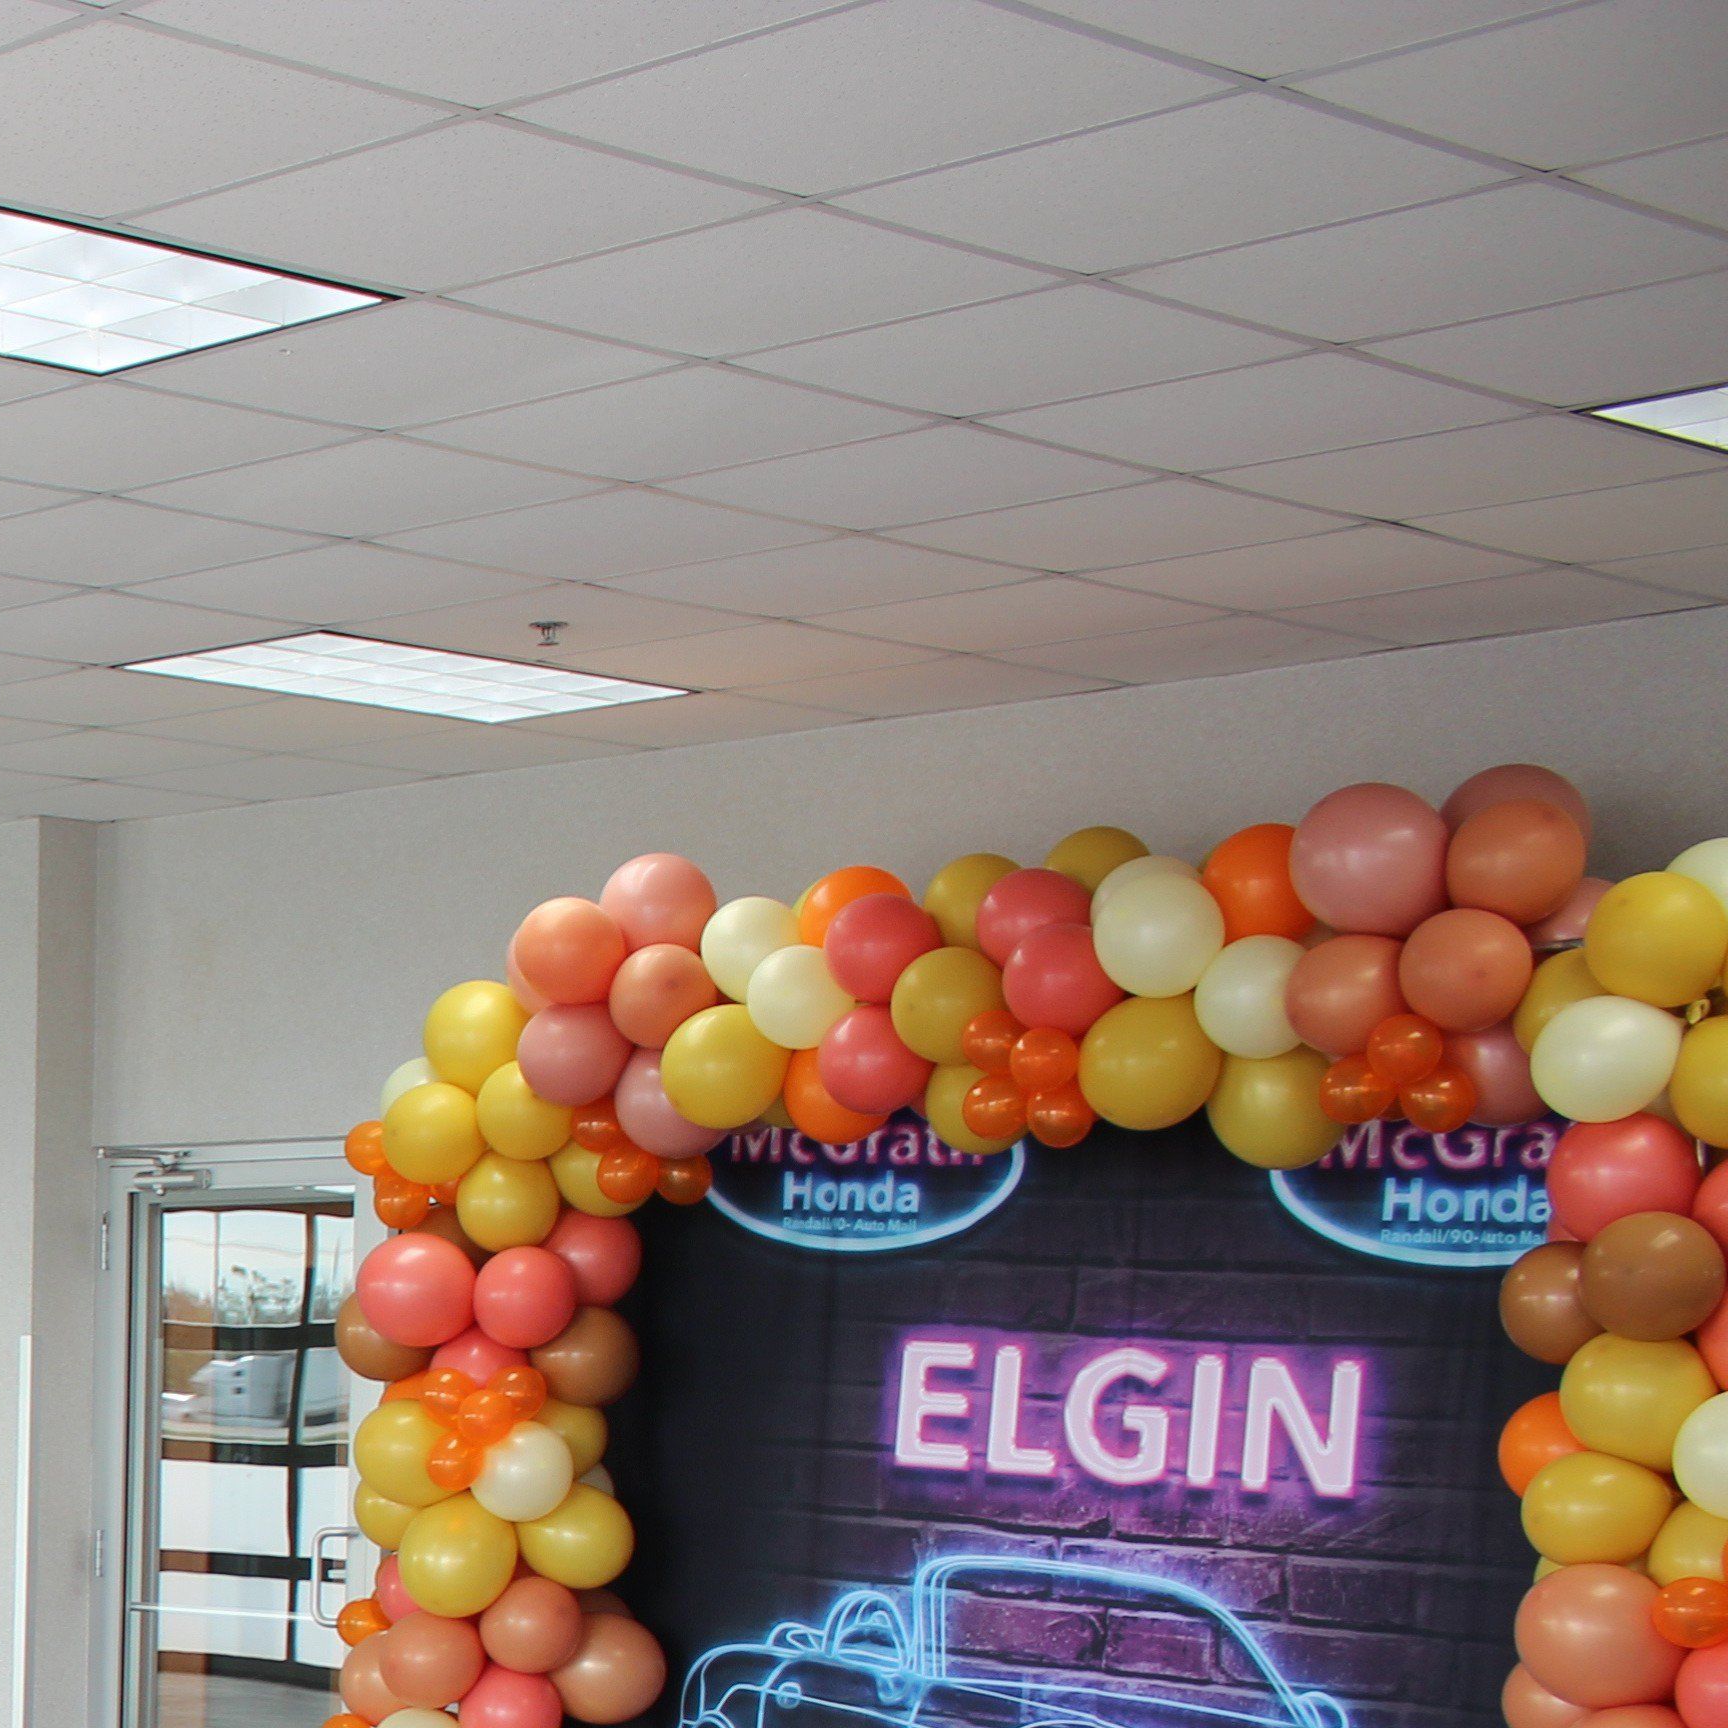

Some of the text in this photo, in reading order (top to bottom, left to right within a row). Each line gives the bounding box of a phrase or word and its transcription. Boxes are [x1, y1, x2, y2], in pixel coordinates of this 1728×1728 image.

[782, 1170, 919, 1213] Honda
[1381, 1174, 1552, 1223] Honda
[894, 1341, 1362, 1499] ELGIN
